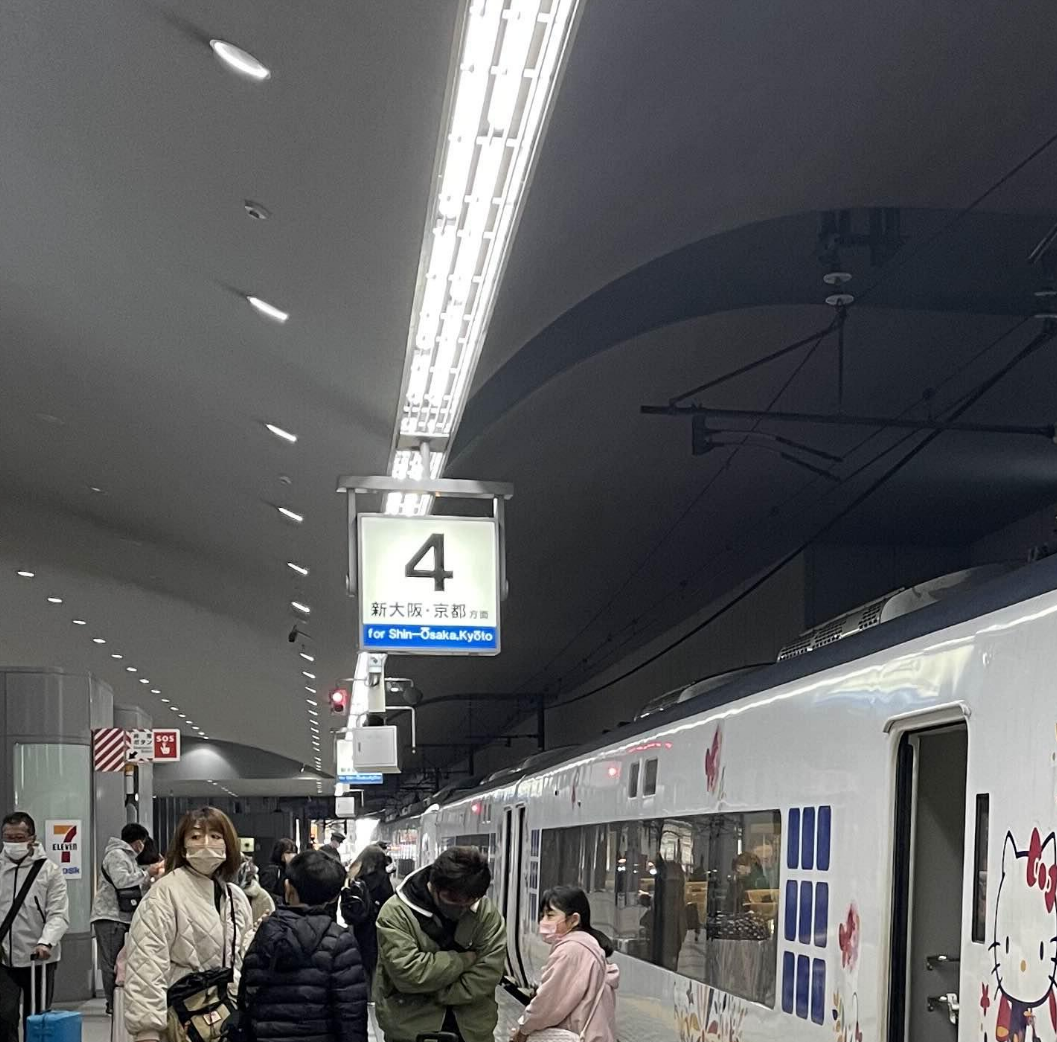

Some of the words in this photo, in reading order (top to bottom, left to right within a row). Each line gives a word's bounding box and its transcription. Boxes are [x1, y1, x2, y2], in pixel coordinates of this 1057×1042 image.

[405, 533, 454, 592] 4
[368, 628, 386, 640] for
[156, 735, 174, 743] SOS
